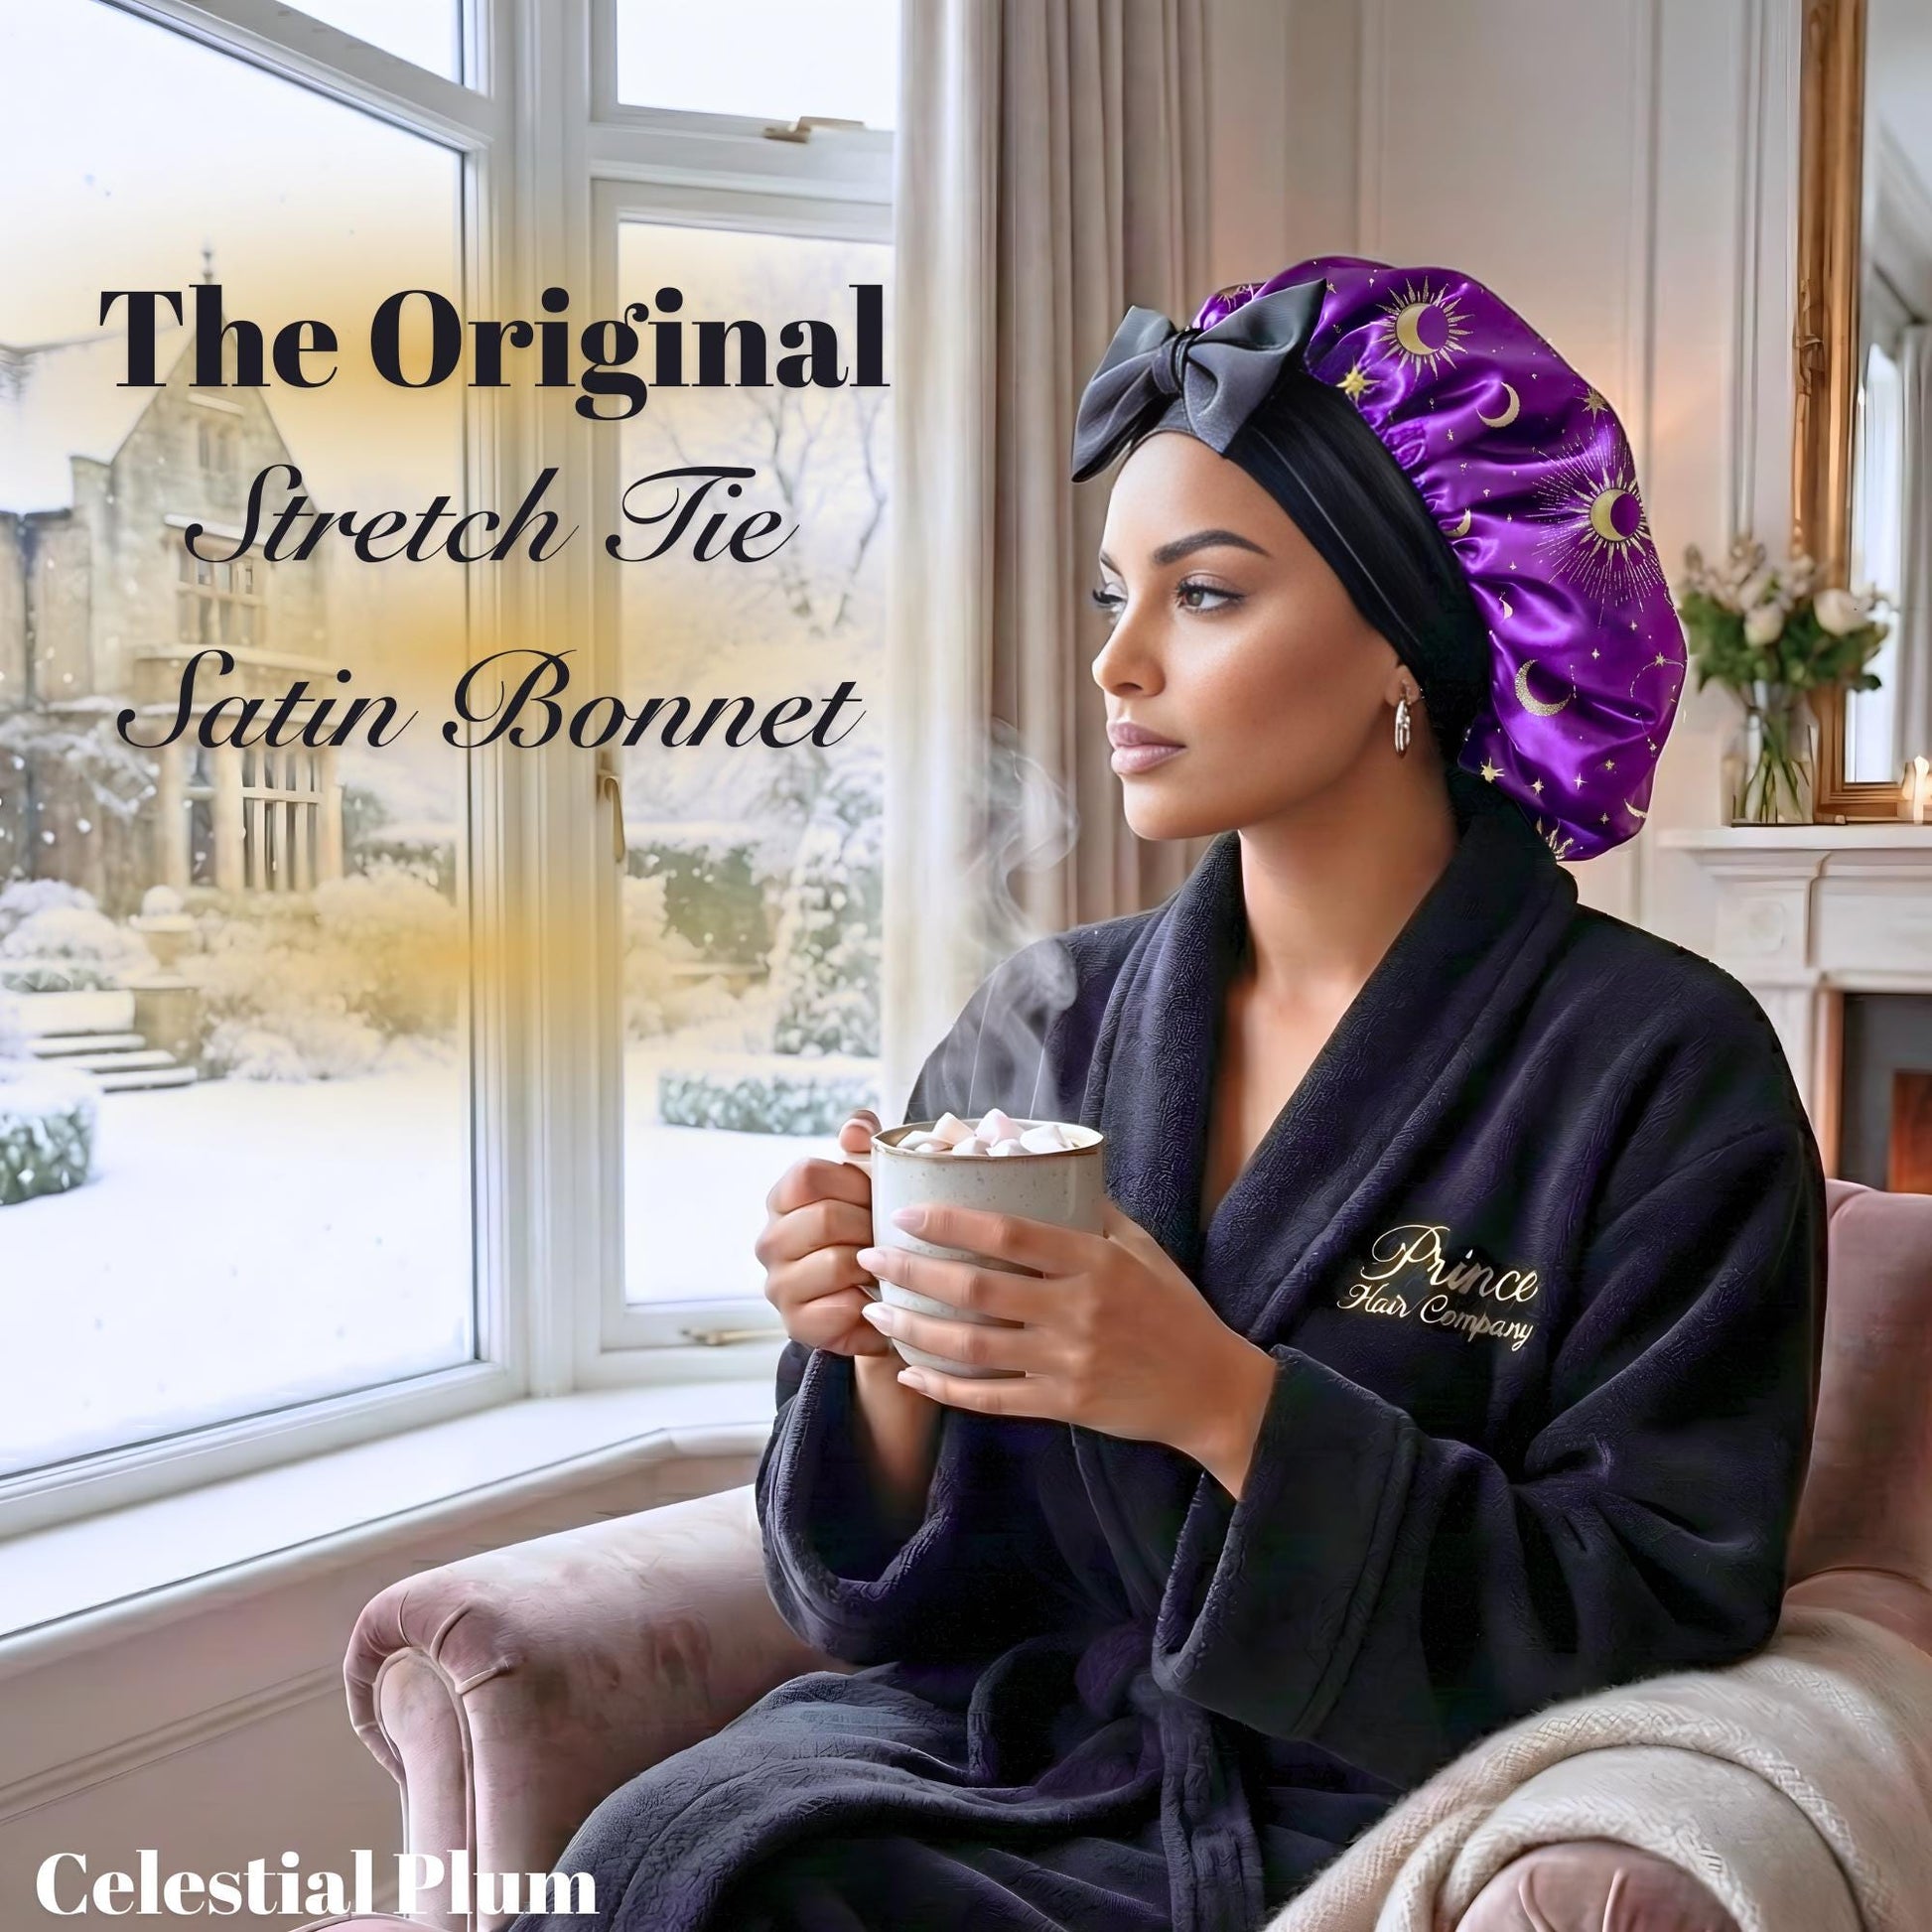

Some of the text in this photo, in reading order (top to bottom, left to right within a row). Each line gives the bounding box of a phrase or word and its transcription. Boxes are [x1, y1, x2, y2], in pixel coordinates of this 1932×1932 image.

[1360, 1224, 1539, 1303] Prince
[1336, 1283, 1534, 1351] Hair Company
